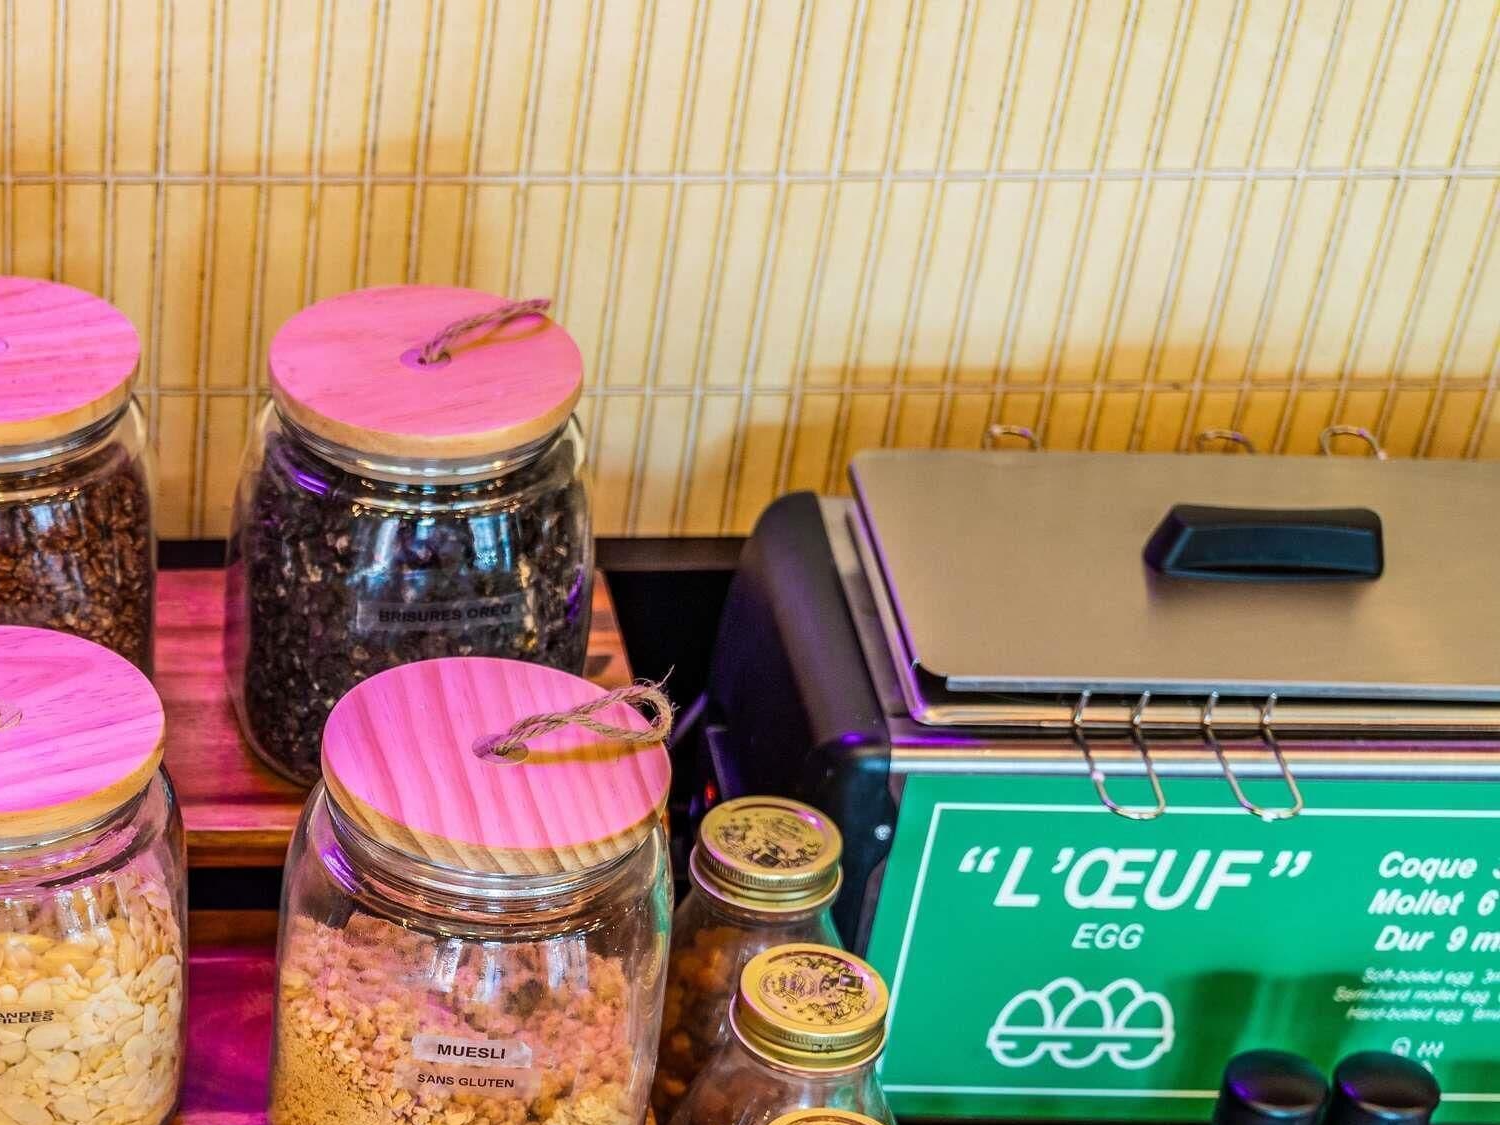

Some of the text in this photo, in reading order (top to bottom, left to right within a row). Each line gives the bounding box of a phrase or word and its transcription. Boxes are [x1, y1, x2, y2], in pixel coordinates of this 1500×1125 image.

[379, 608, 462, 623] BRISURES
[1378, 850, 1478, 885] Coque
[1367, 887, 1465, 917] Mollet
[1071, 922, 1146, 951] EGG
[1374, 924, 1436, 952] Dur
[1445, 926, 1469, 953] 9
[437, 1043, 506, 1060] MUESLI
[417, 1073, 515, 1089] SANS GLUTEN
